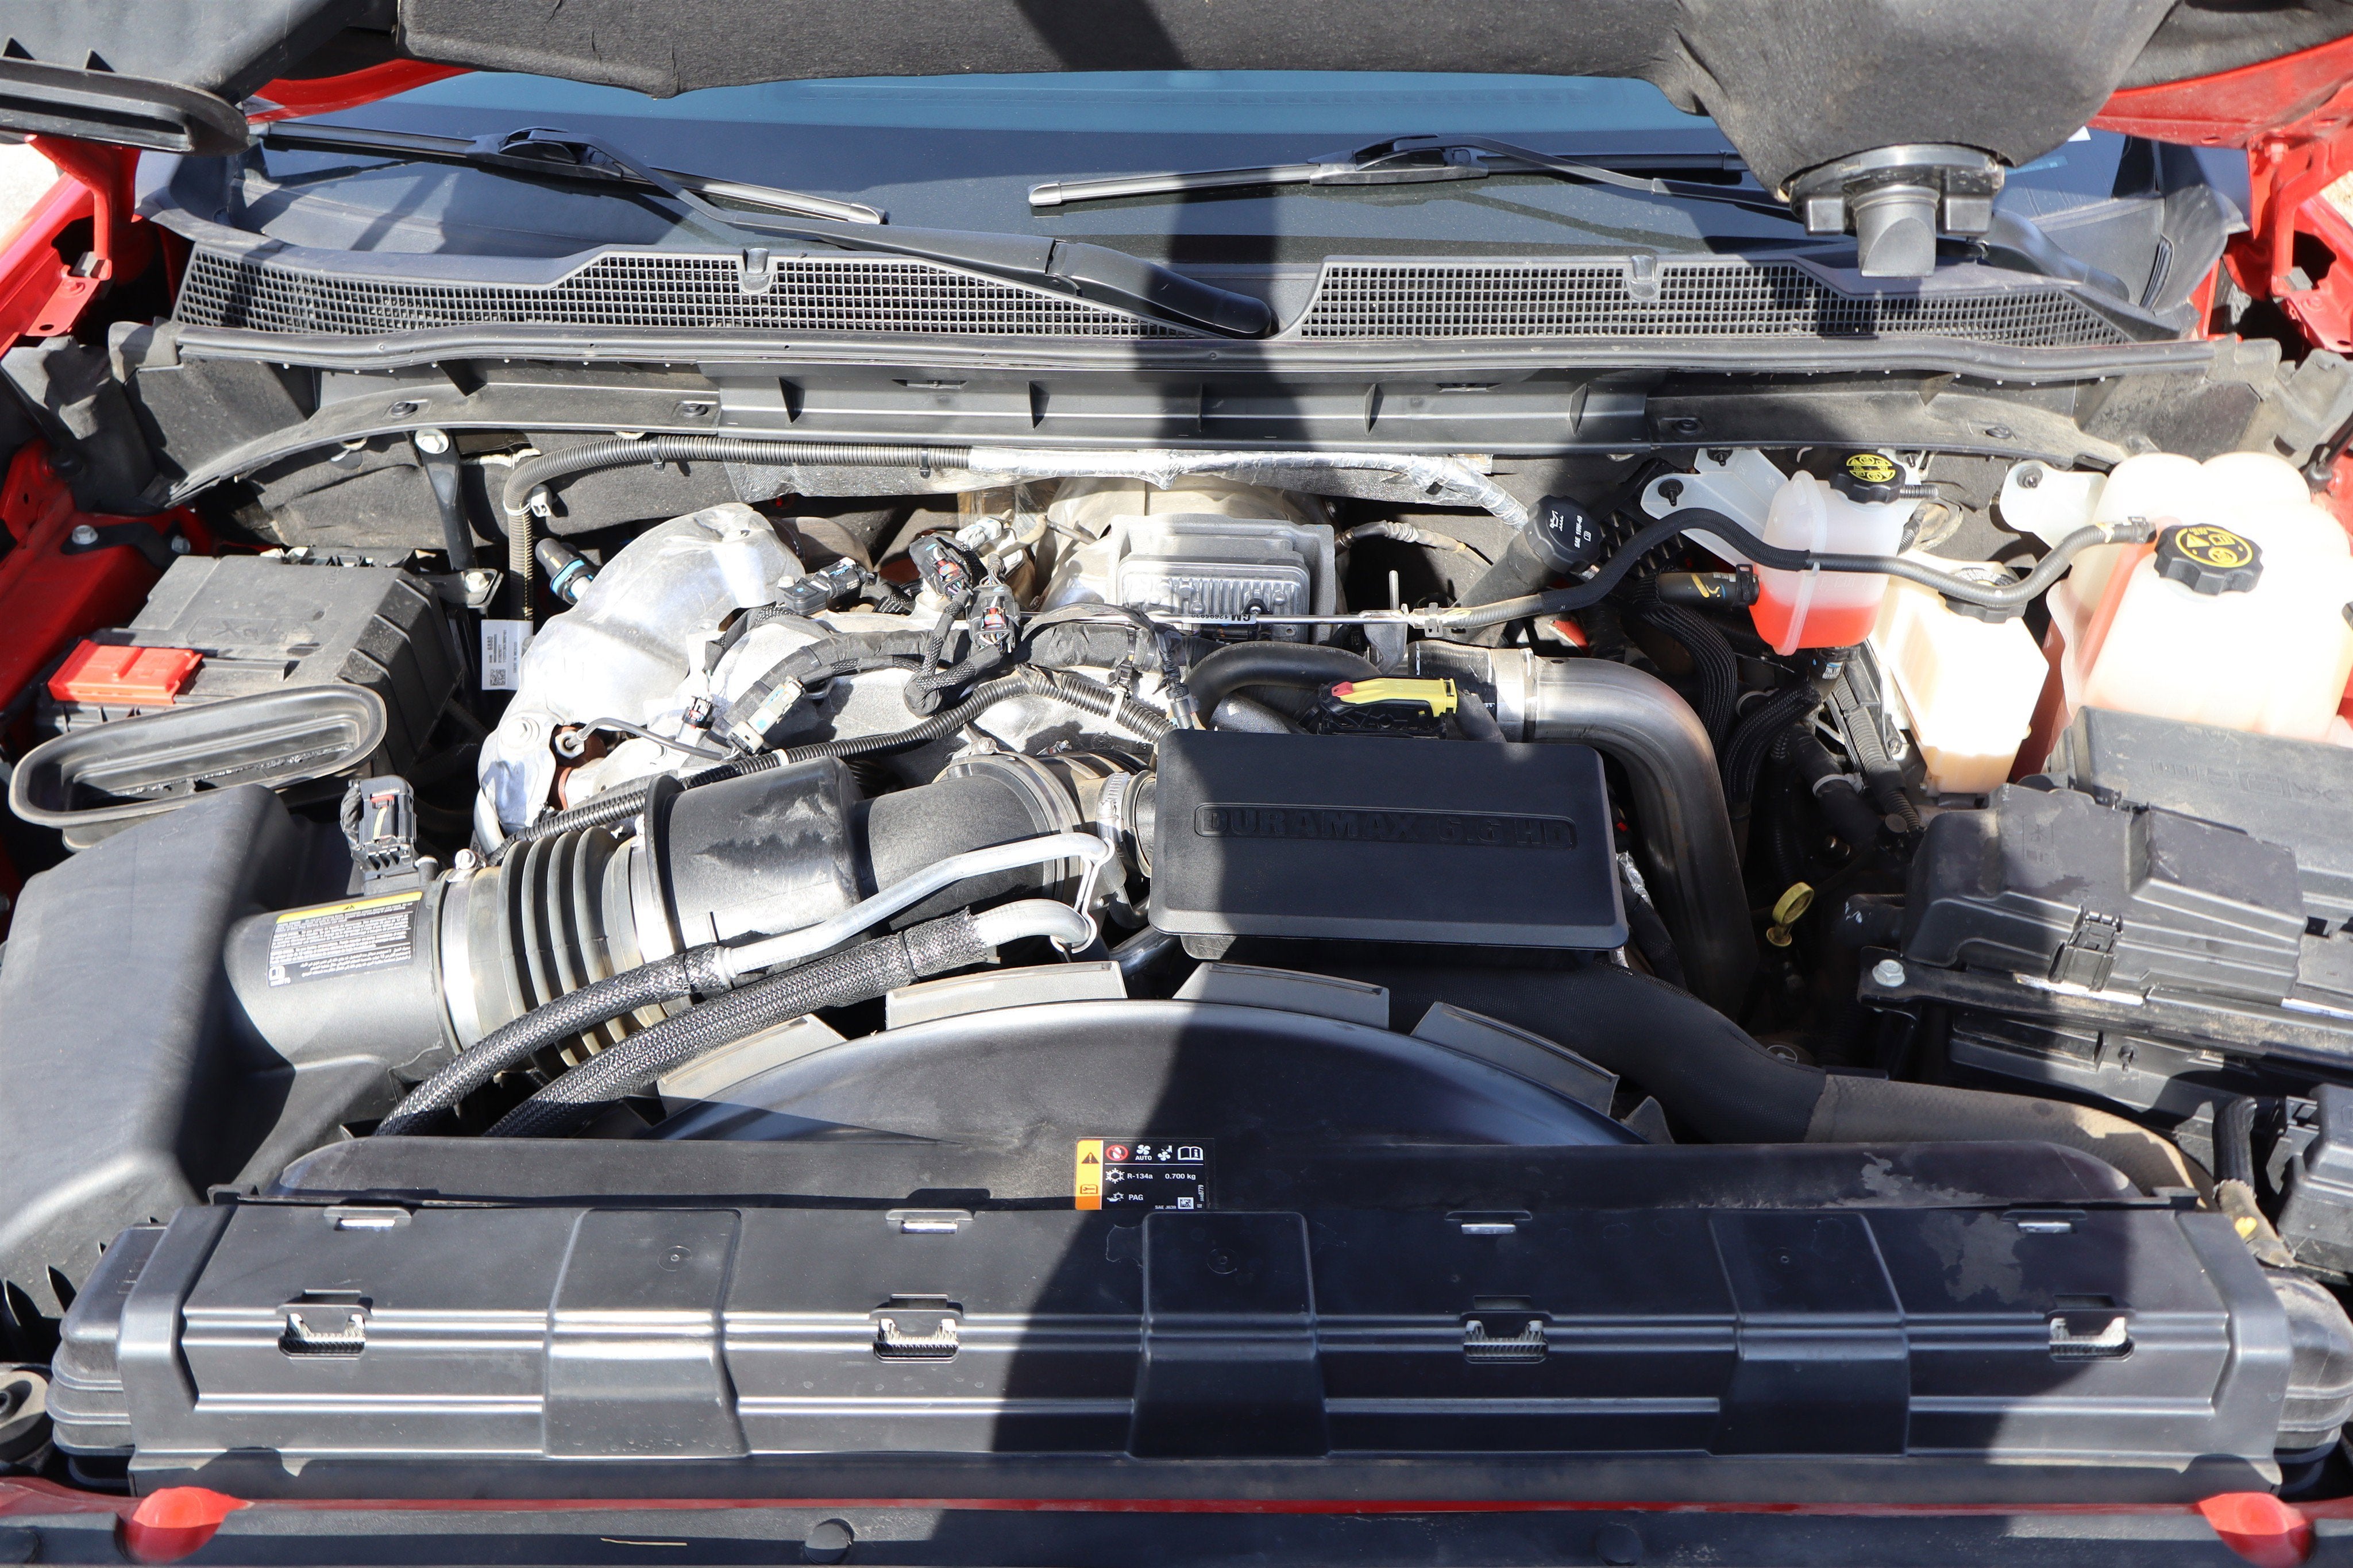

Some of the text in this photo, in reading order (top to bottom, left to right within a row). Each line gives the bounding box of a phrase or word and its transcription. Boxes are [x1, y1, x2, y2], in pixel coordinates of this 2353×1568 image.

[1206, 809, 1573, 848] DURAMAX 6.6 HD
